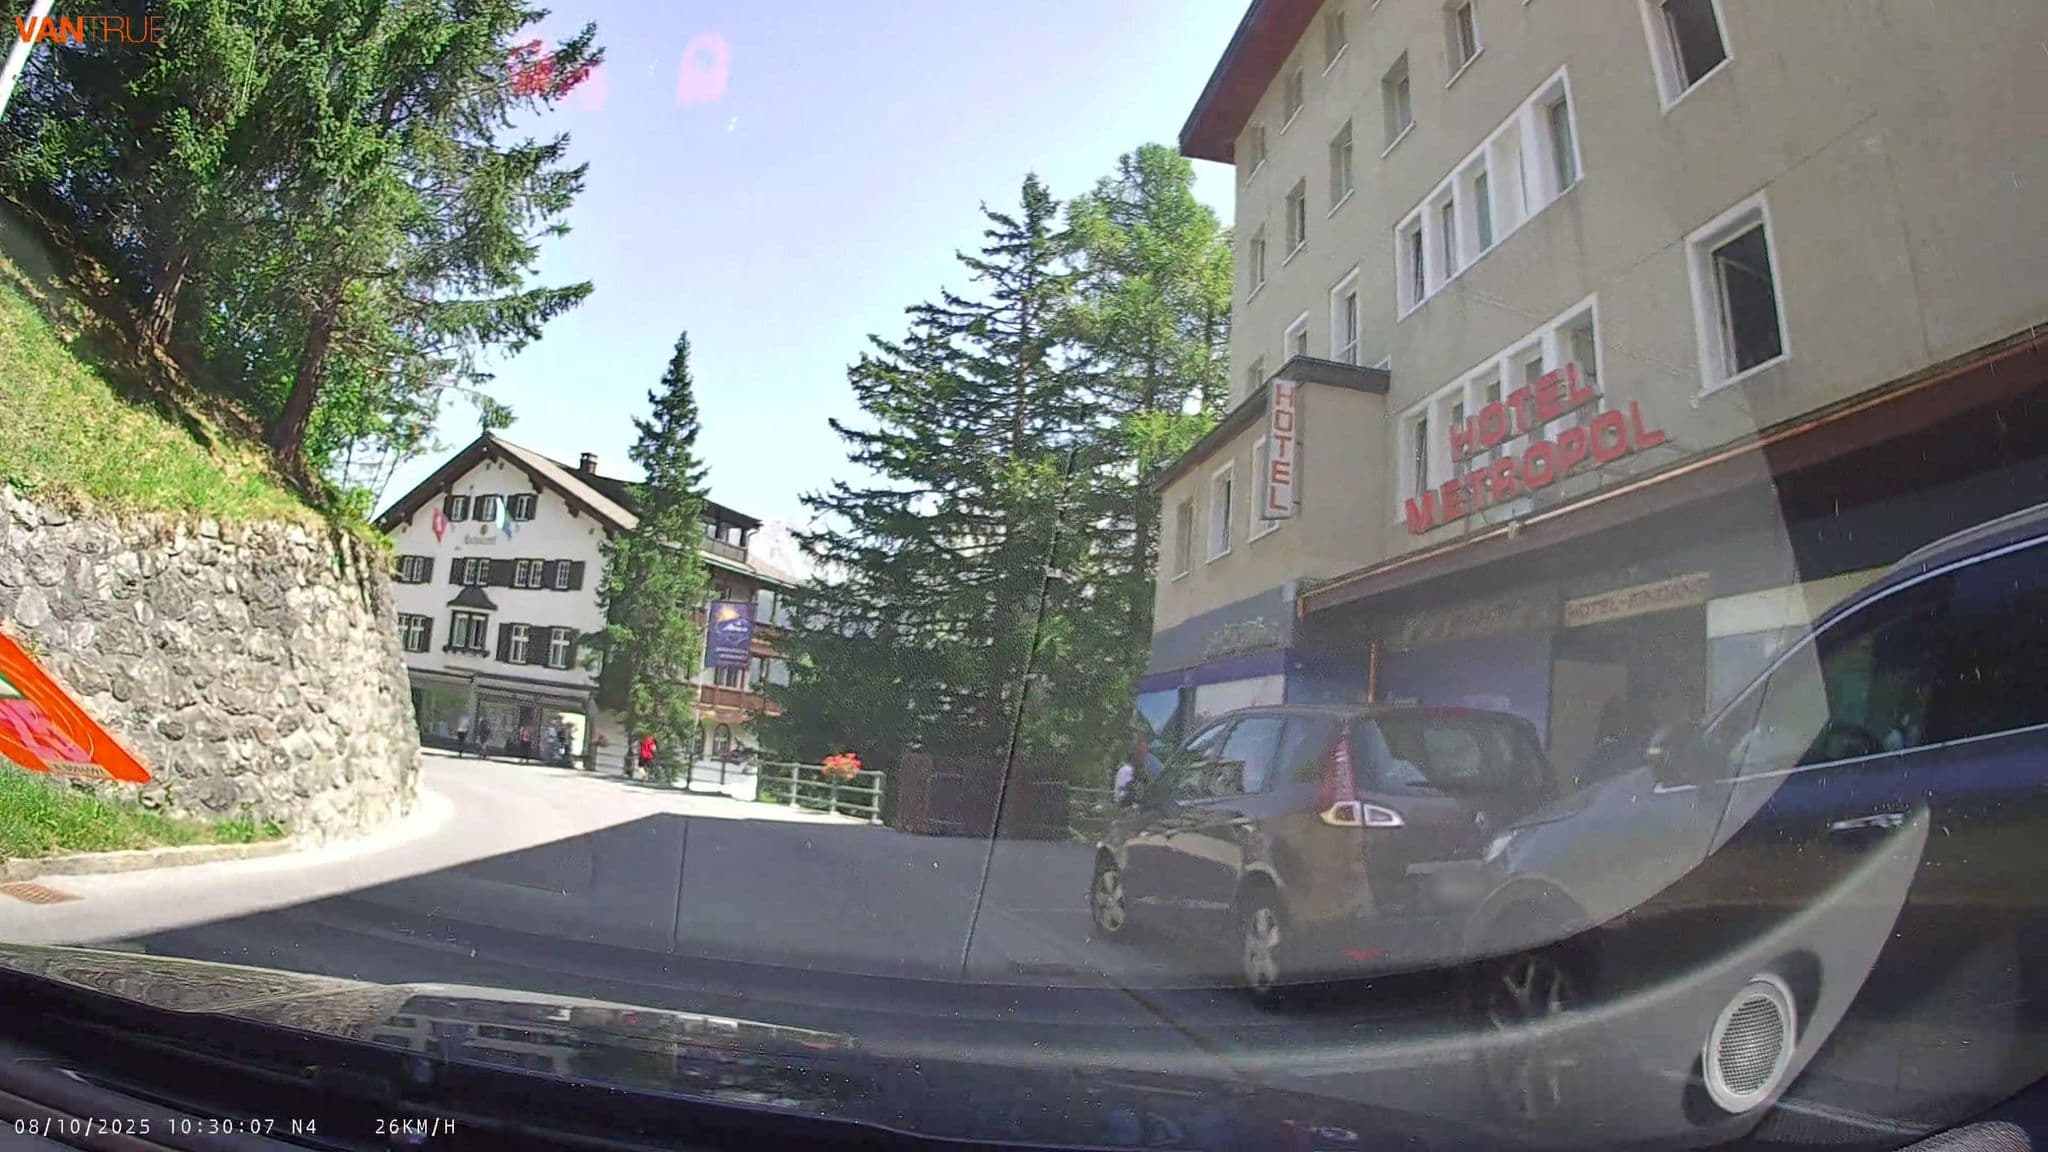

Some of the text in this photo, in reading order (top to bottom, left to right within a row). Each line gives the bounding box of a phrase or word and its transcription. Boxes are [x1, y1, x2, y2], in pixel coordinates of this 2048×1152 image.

[1269, 383, 1296, 511] HOTEL
[1405, 400, 1665, 535] METROPOL
[1450, 362, 1595, 463] HOTEL
